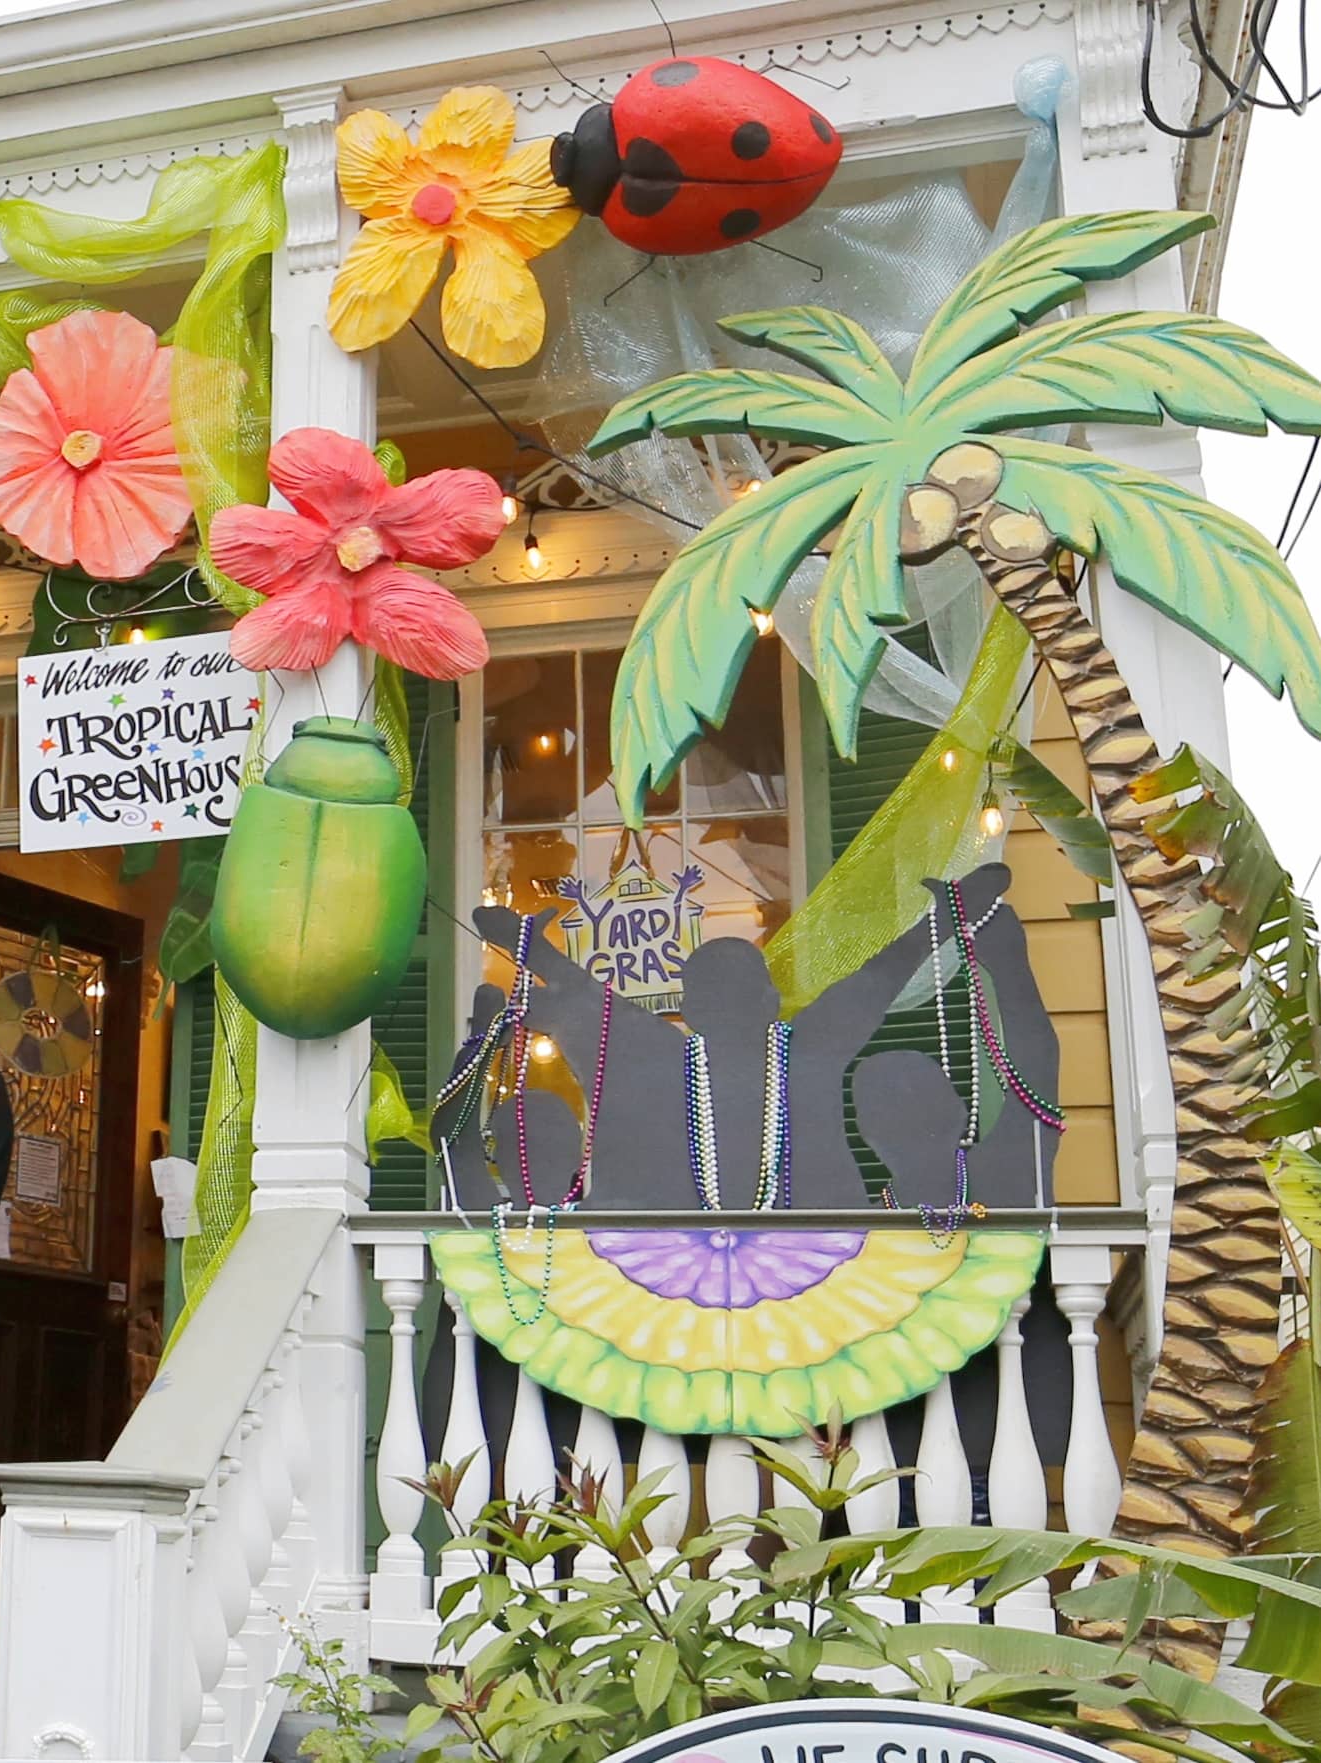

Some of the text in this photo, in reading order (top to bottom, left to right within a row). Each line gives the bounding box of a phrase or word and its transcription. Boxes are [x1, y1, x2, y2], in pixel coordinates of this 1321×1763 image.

[41, 655, 150, 699] Welcome
[155, 650, 191, 681] to
[46, 696, 253, 760] TROPICAL
[586, 940, 686, 991] GRAS
